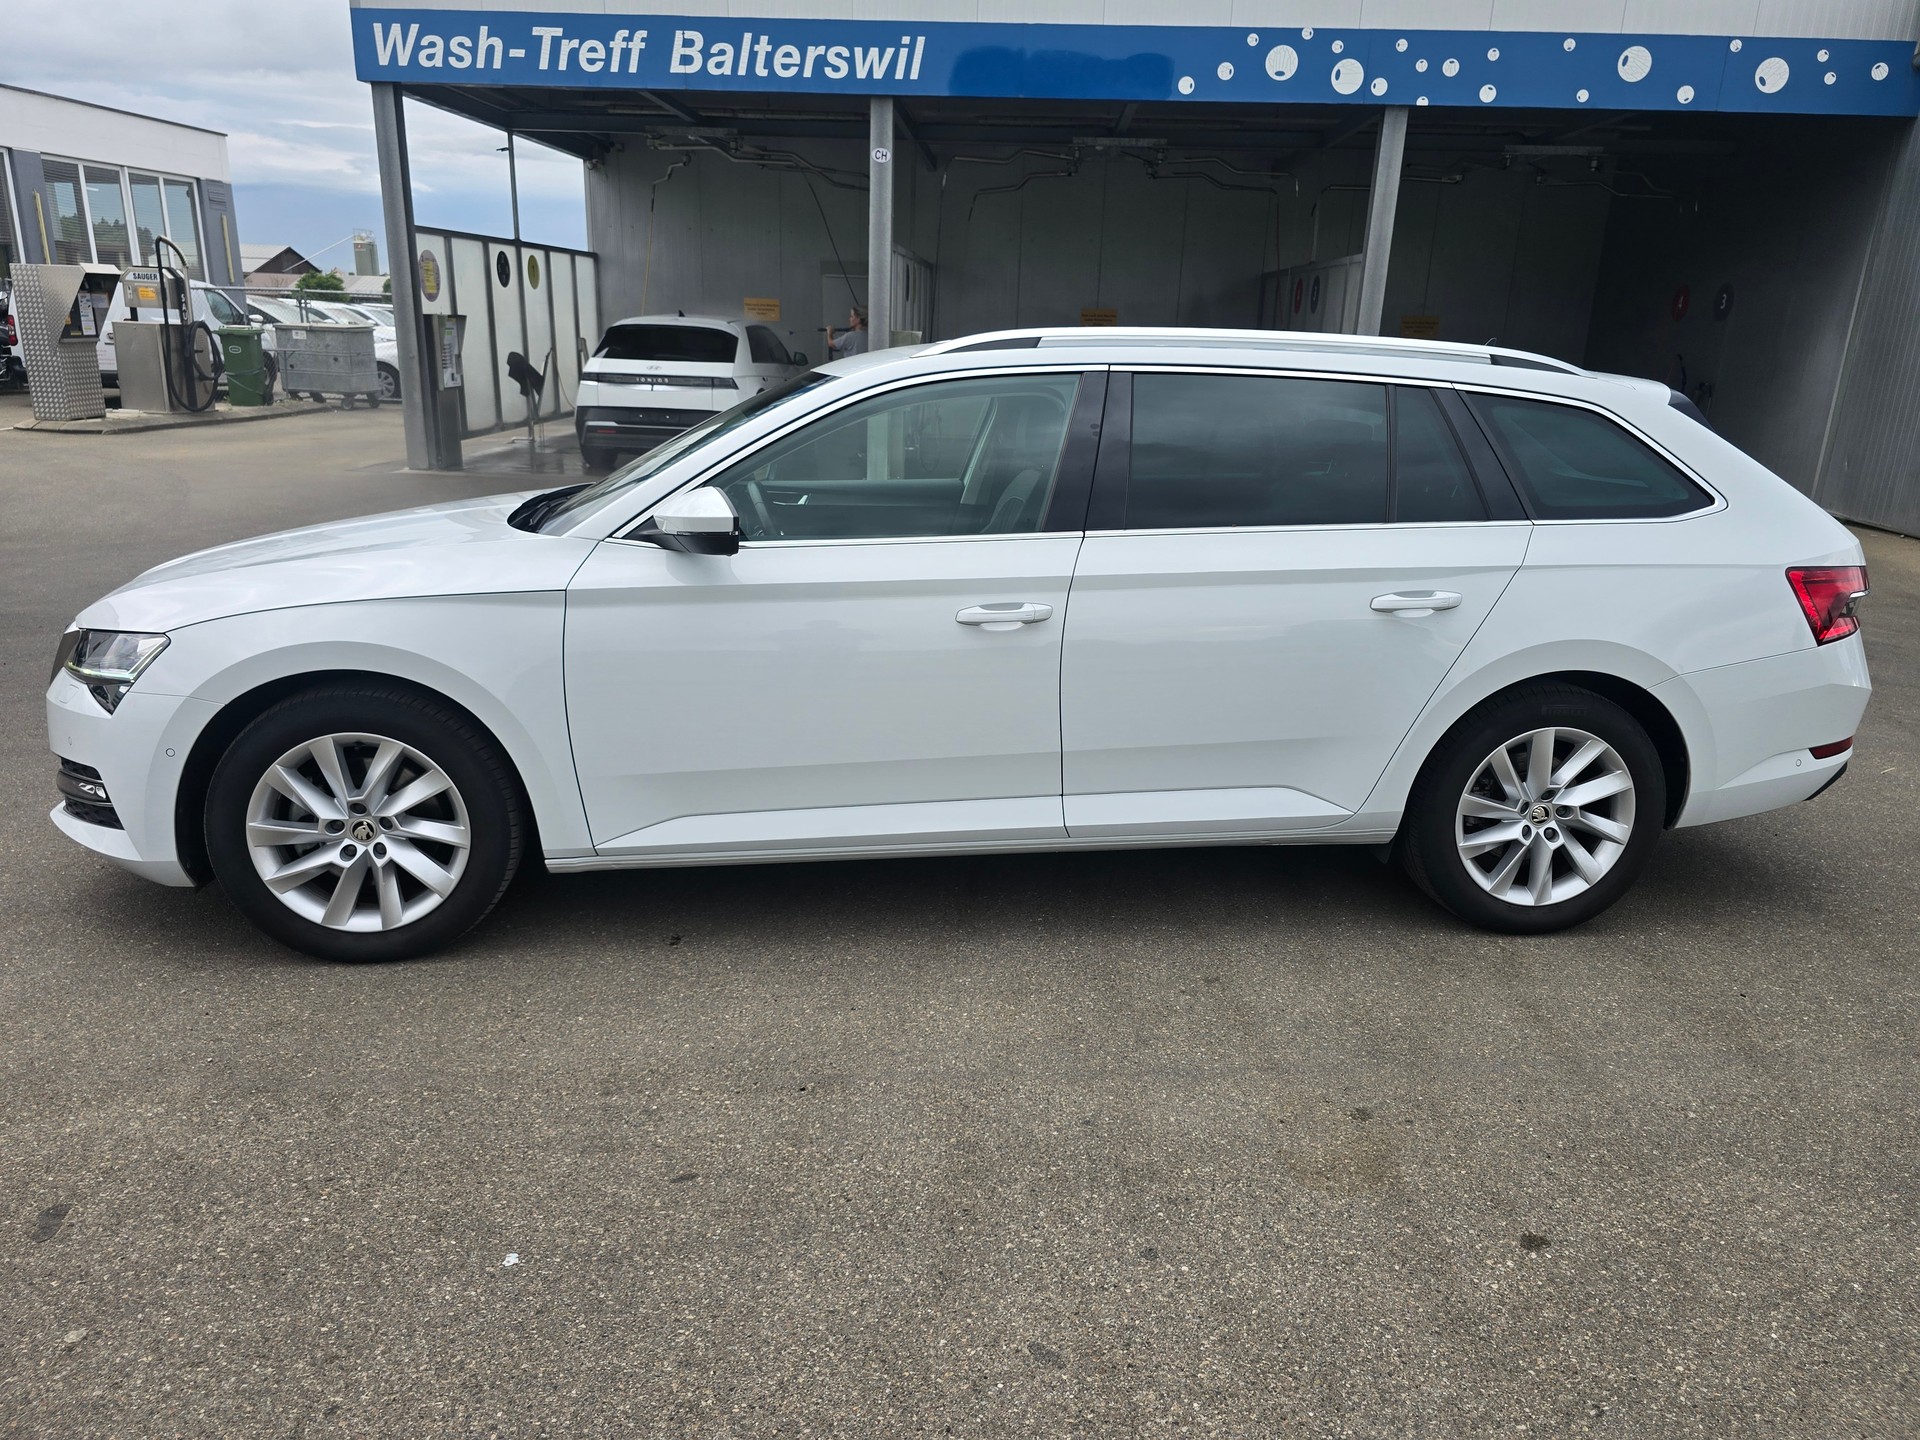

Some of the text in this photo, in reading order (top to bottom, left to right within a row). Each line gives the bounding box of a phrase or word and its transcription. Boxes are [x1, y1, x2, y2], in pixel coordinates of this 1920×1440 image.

[373, 22, 926, 80] Wash-Treff Balterswil
[874, 149, 888, 161] CH
[132, 272, 159, 281] SAUGER
[1719, 293, 1727, 310] 3
